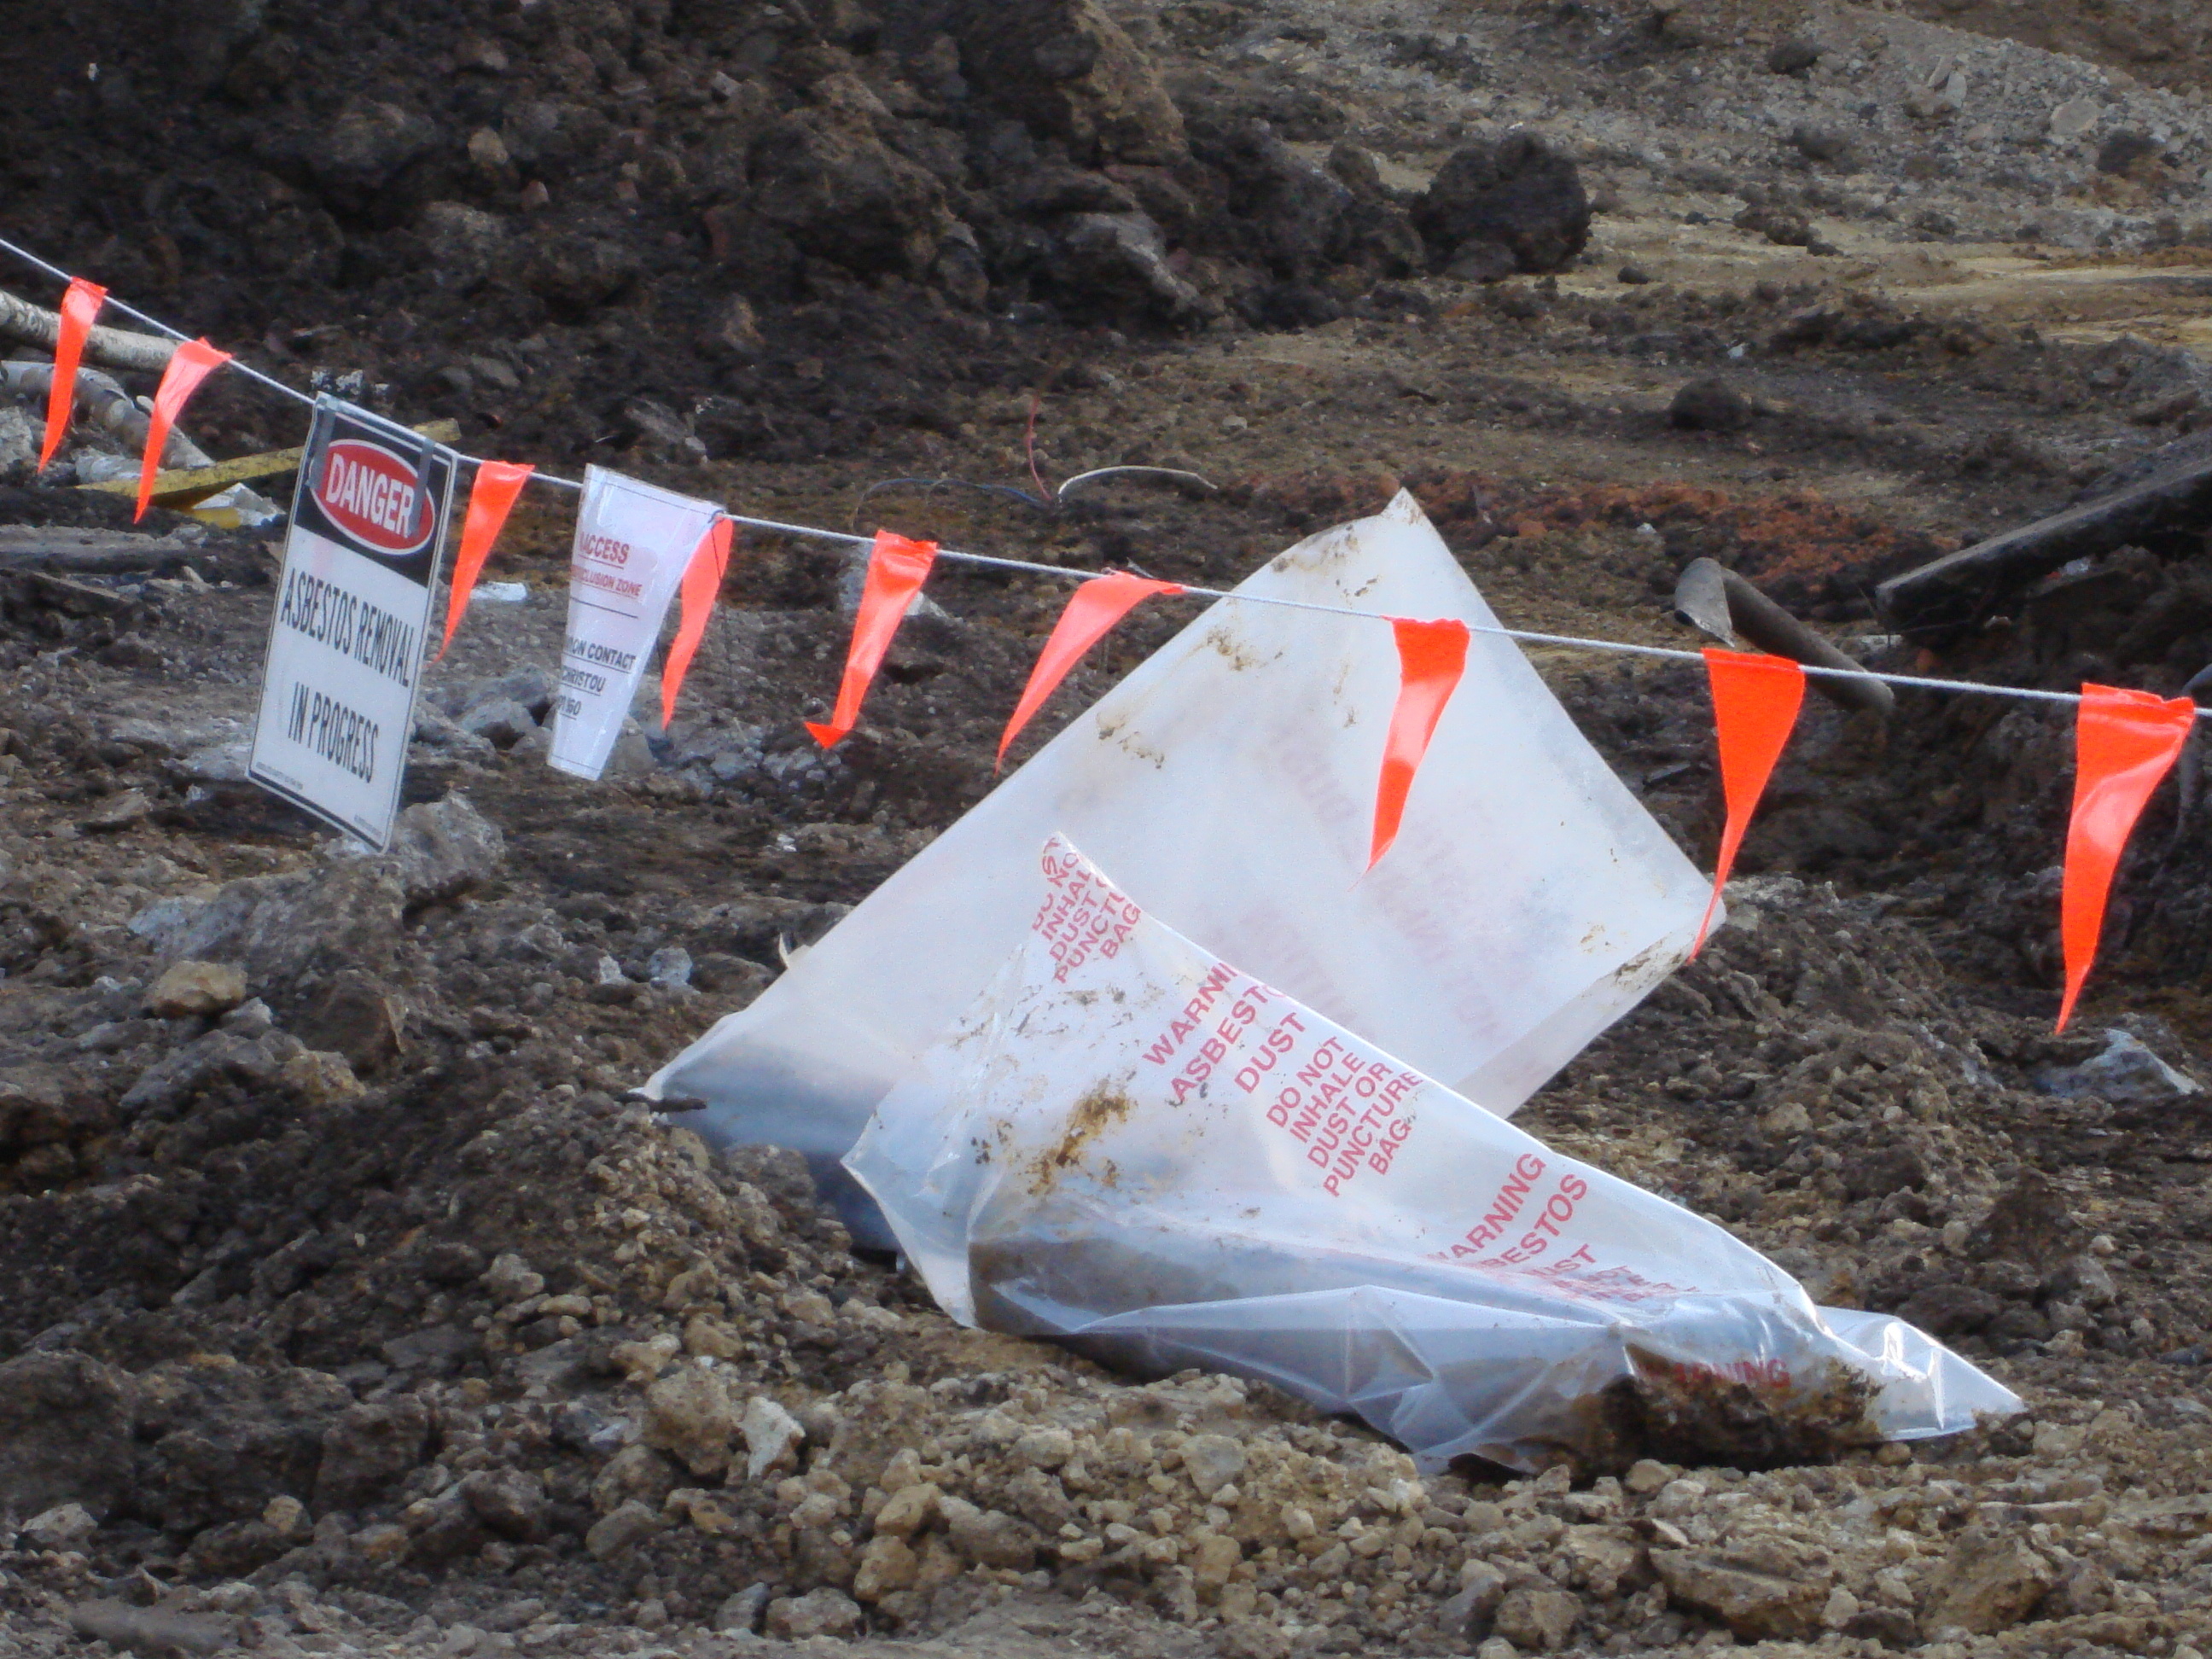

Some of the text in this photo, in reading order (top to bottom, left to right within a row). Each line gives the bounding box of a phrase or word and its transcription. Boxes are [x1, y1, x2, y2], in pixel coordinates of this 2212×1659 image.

[326, 453, 415, 538] DANGER
[281, 568, 414, 688] ASBESTOS REMOVAL
[615, 578, 642, 597] ZONE
[588, 643, 636, 671] CONTACT
[288, 681, 379, 783] IN PROGRESS
[1049, 890, 1097, 962] DUST
[1100, 903, 1141, 959] BAG
[1234, 1011, 1306, 1093] DUST
[1266, 1036, 1344, 1128] DO NOT
[1289, 1052, 1365, 1144] INHALE
[1307, 1062, 1394, 1168] DUST OR
[1323, 1071, 1423, 1197] PUNCTURE
[1368, 1119, 1412, 1175] BAG
